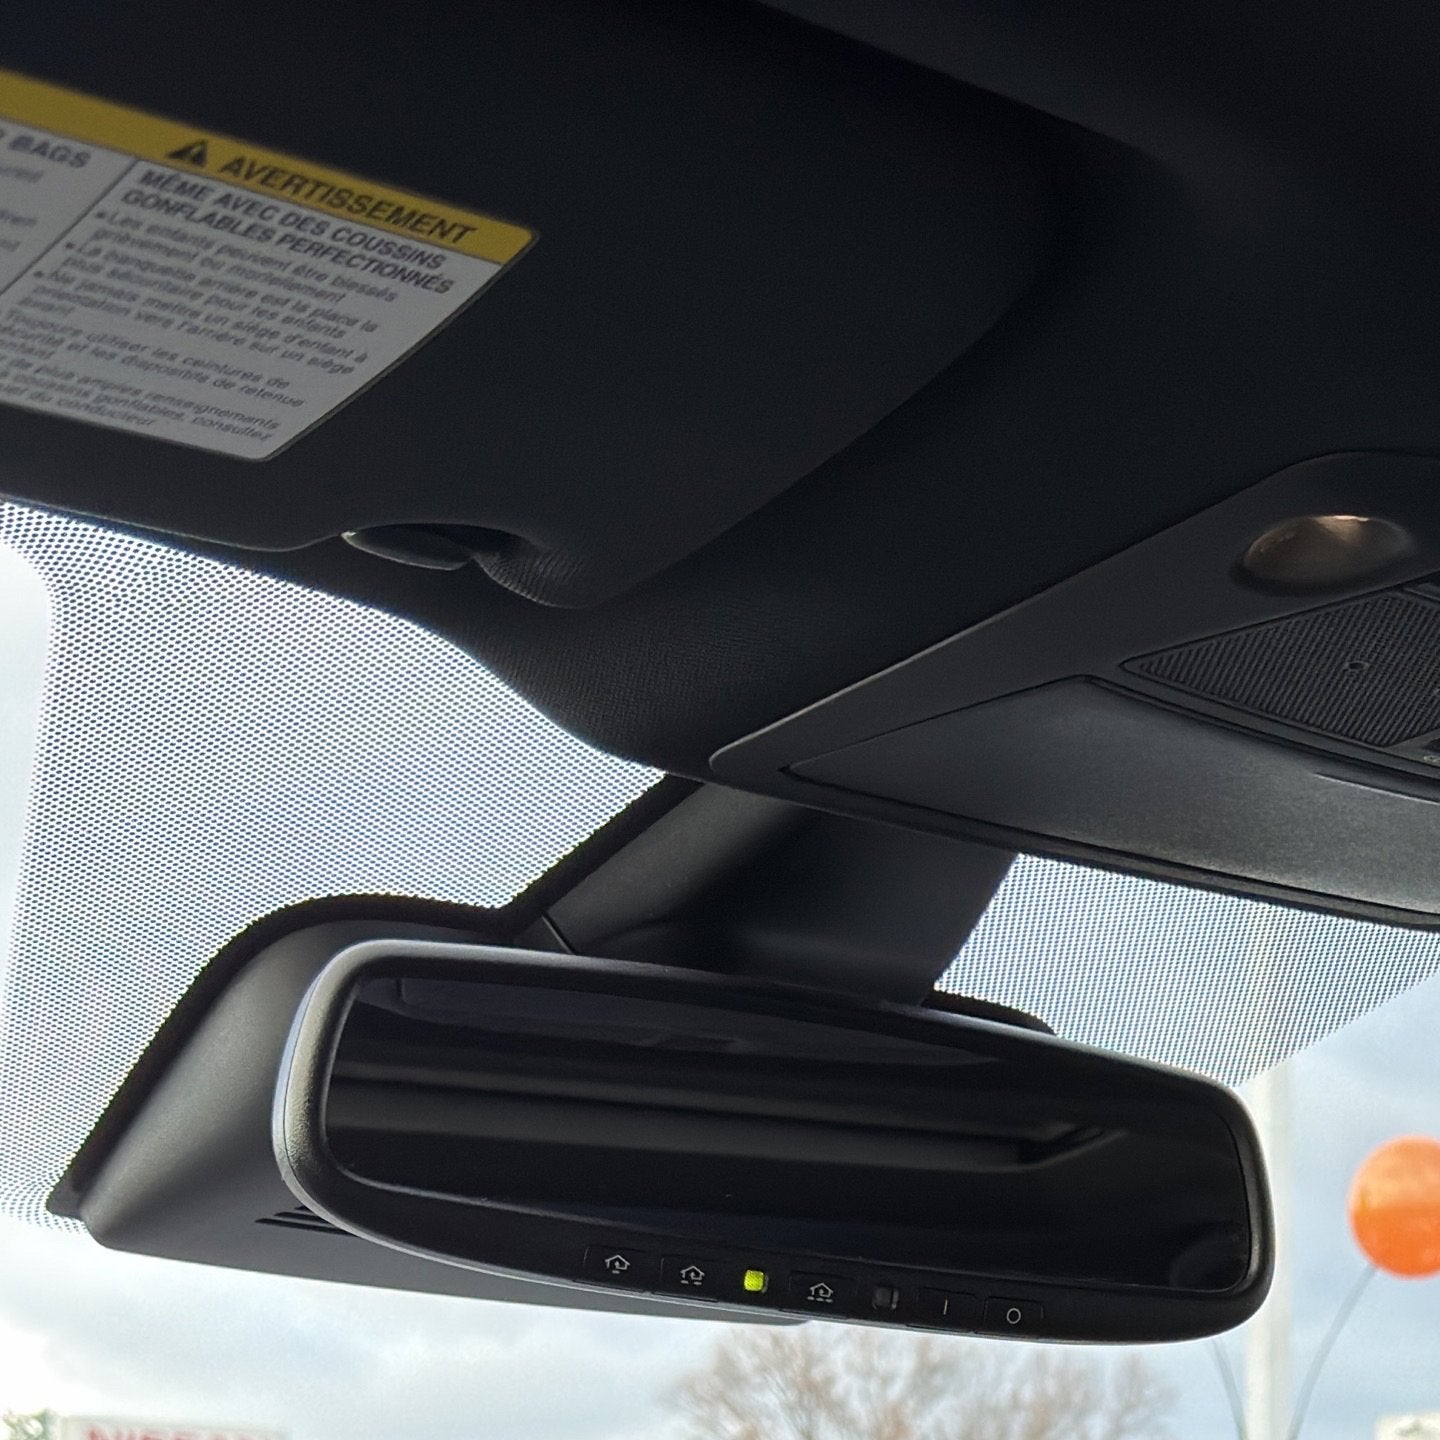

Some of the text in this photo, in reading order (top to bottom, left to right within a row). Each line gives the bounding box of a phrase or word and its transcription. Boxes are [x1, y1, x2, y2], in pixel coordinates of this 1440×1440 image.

[8, 132, 93, 171] BAGS
[116, 188, 460, 293] GONFLABLES PERFECTIONNÉS
[209, 190, 286, 222] AVEC
[273, 209, 335, 236] DES
[325, 224, 453, 269] COUSSINS
[221, 156, 478, 245] AVERTISSEMENT
